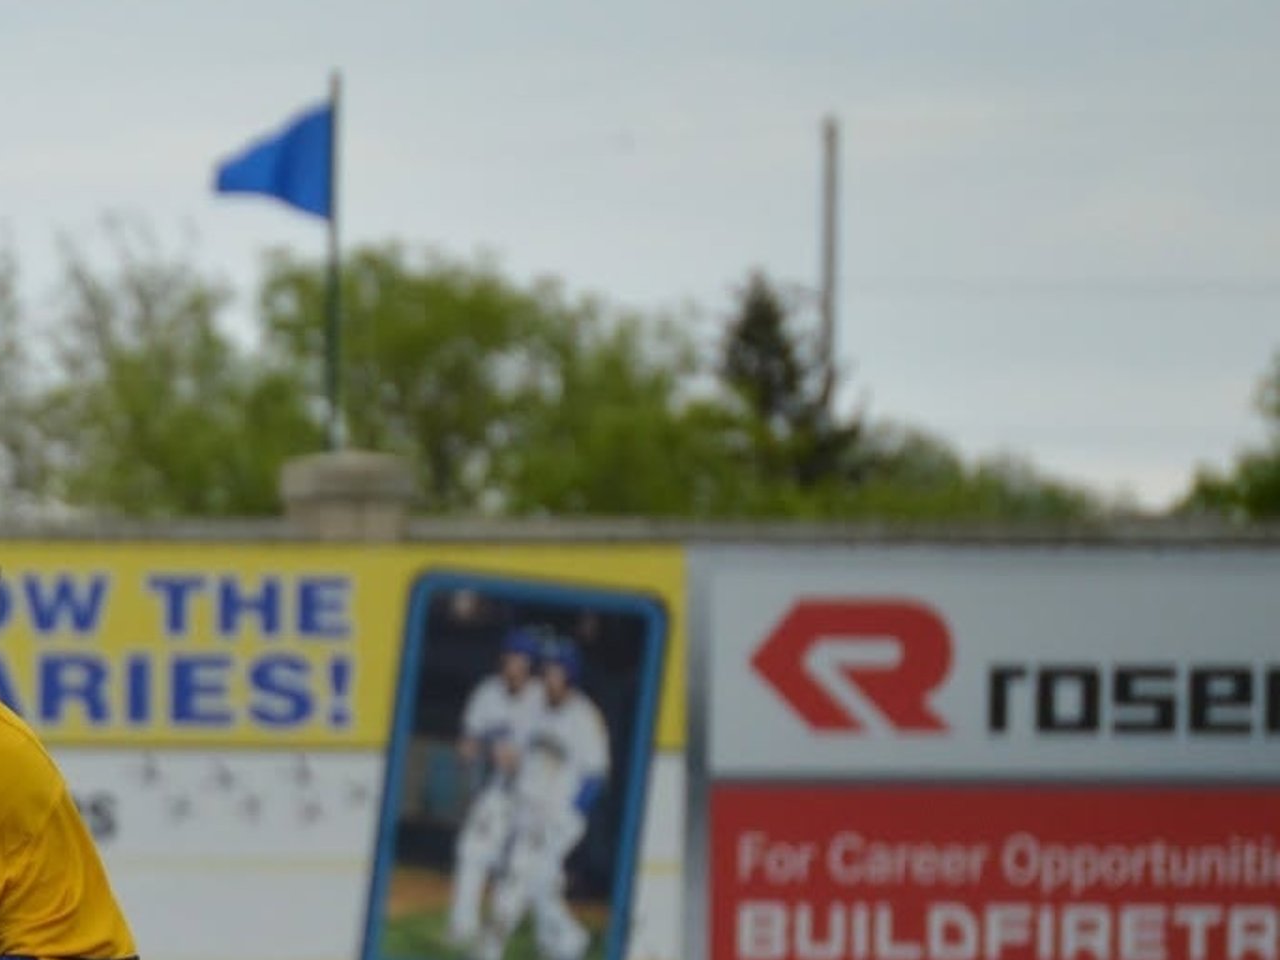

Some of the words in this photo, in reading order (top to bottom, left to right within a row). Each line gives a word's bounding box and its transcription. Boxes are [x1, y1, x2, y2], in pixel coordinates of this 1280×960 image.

[147, 575, 353, 638] THE
[987, 665, 1280, 733] rose
[740, 836, 815, 885] For
[828, 834, 986, 885] Career
